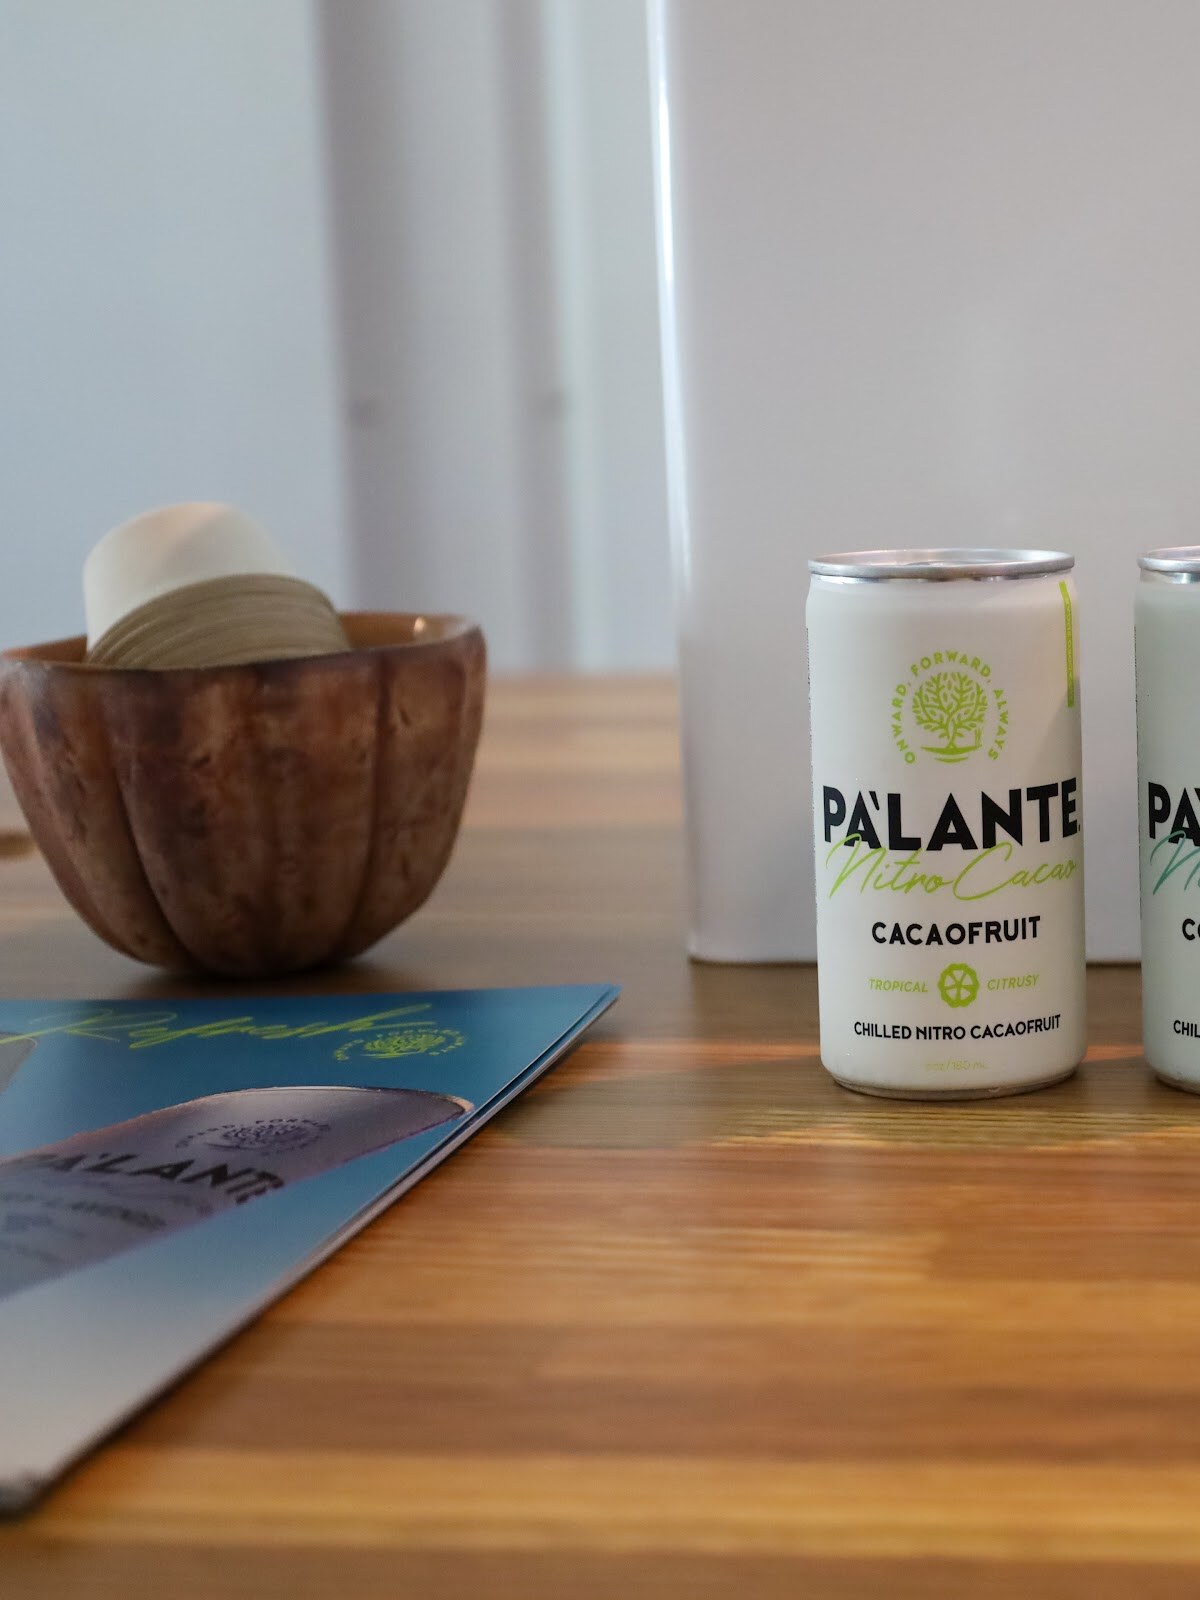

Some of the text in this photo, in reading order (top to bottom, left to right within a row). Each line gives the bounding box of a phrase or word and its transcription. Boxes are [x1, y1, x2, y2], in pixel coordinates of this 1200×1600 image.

[988, 688, 1009, 760] ALWAYS
[825, 833, 1079, 901] Nitro Cacao
[871, 915, 1041, 946] CACAOFRUIT
[869, 974, 1040, 993] TROPICAL CITRUSY
[854, 1014, 1061, 1040] CHILLED NITRO CACAOFRUIT
